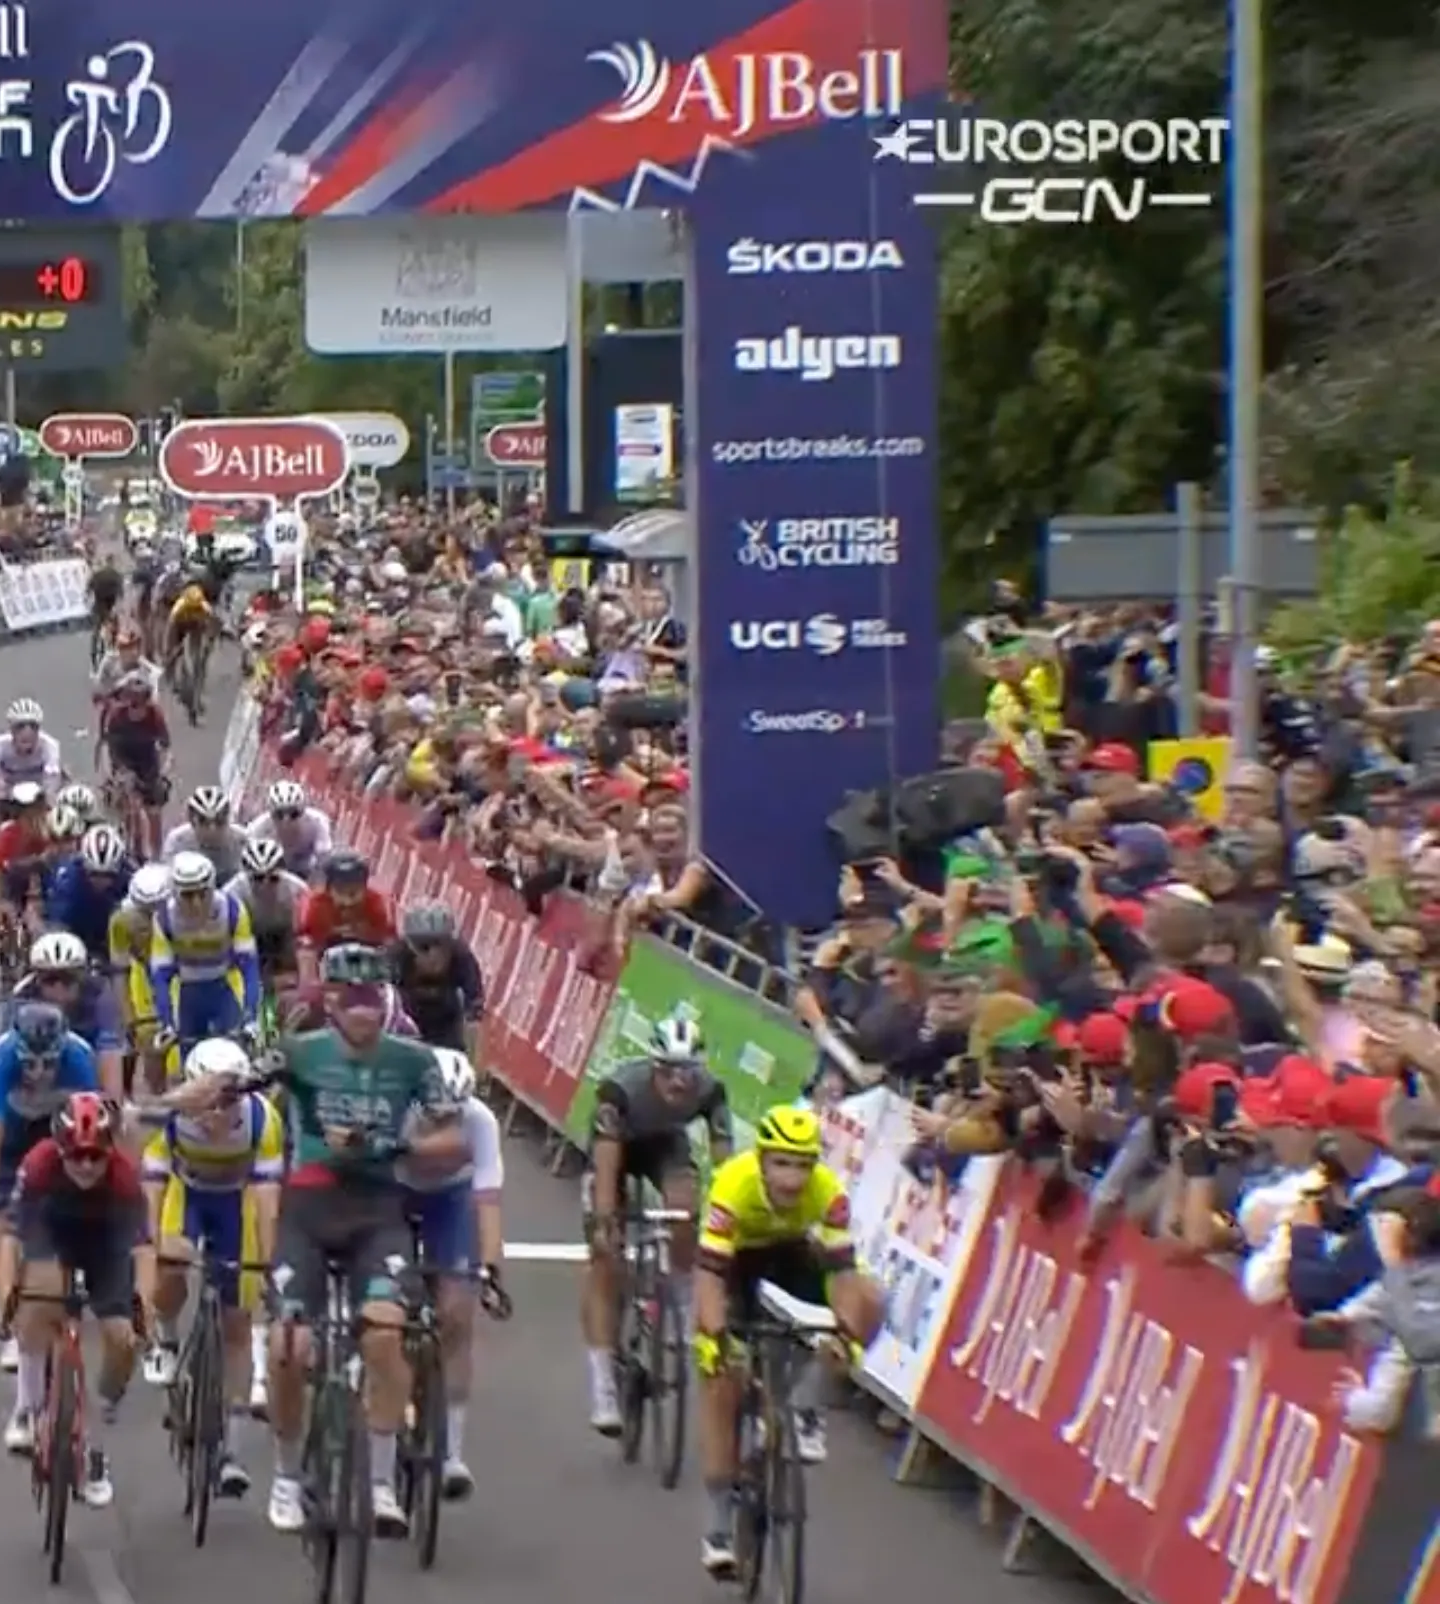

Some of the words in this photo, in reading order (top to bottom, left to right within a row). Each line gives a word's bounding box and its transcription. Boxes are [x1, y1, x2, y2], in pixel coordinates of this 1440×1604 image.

[727, 238, 904, 275] ŠKODA
[380, 304, 492, 328] Mansfield
[736, 327, 901, 381] adyen
[223, 443, 325, 482] AJBell
[712, 435, 924, 463] sportsbreaks.com
[274, 523, 298, 542] 50
[776, 516, 898, 542] BRITISH
[777, 542, 899, 566] CYCLING
[730, 620, 801, 649] UCI
